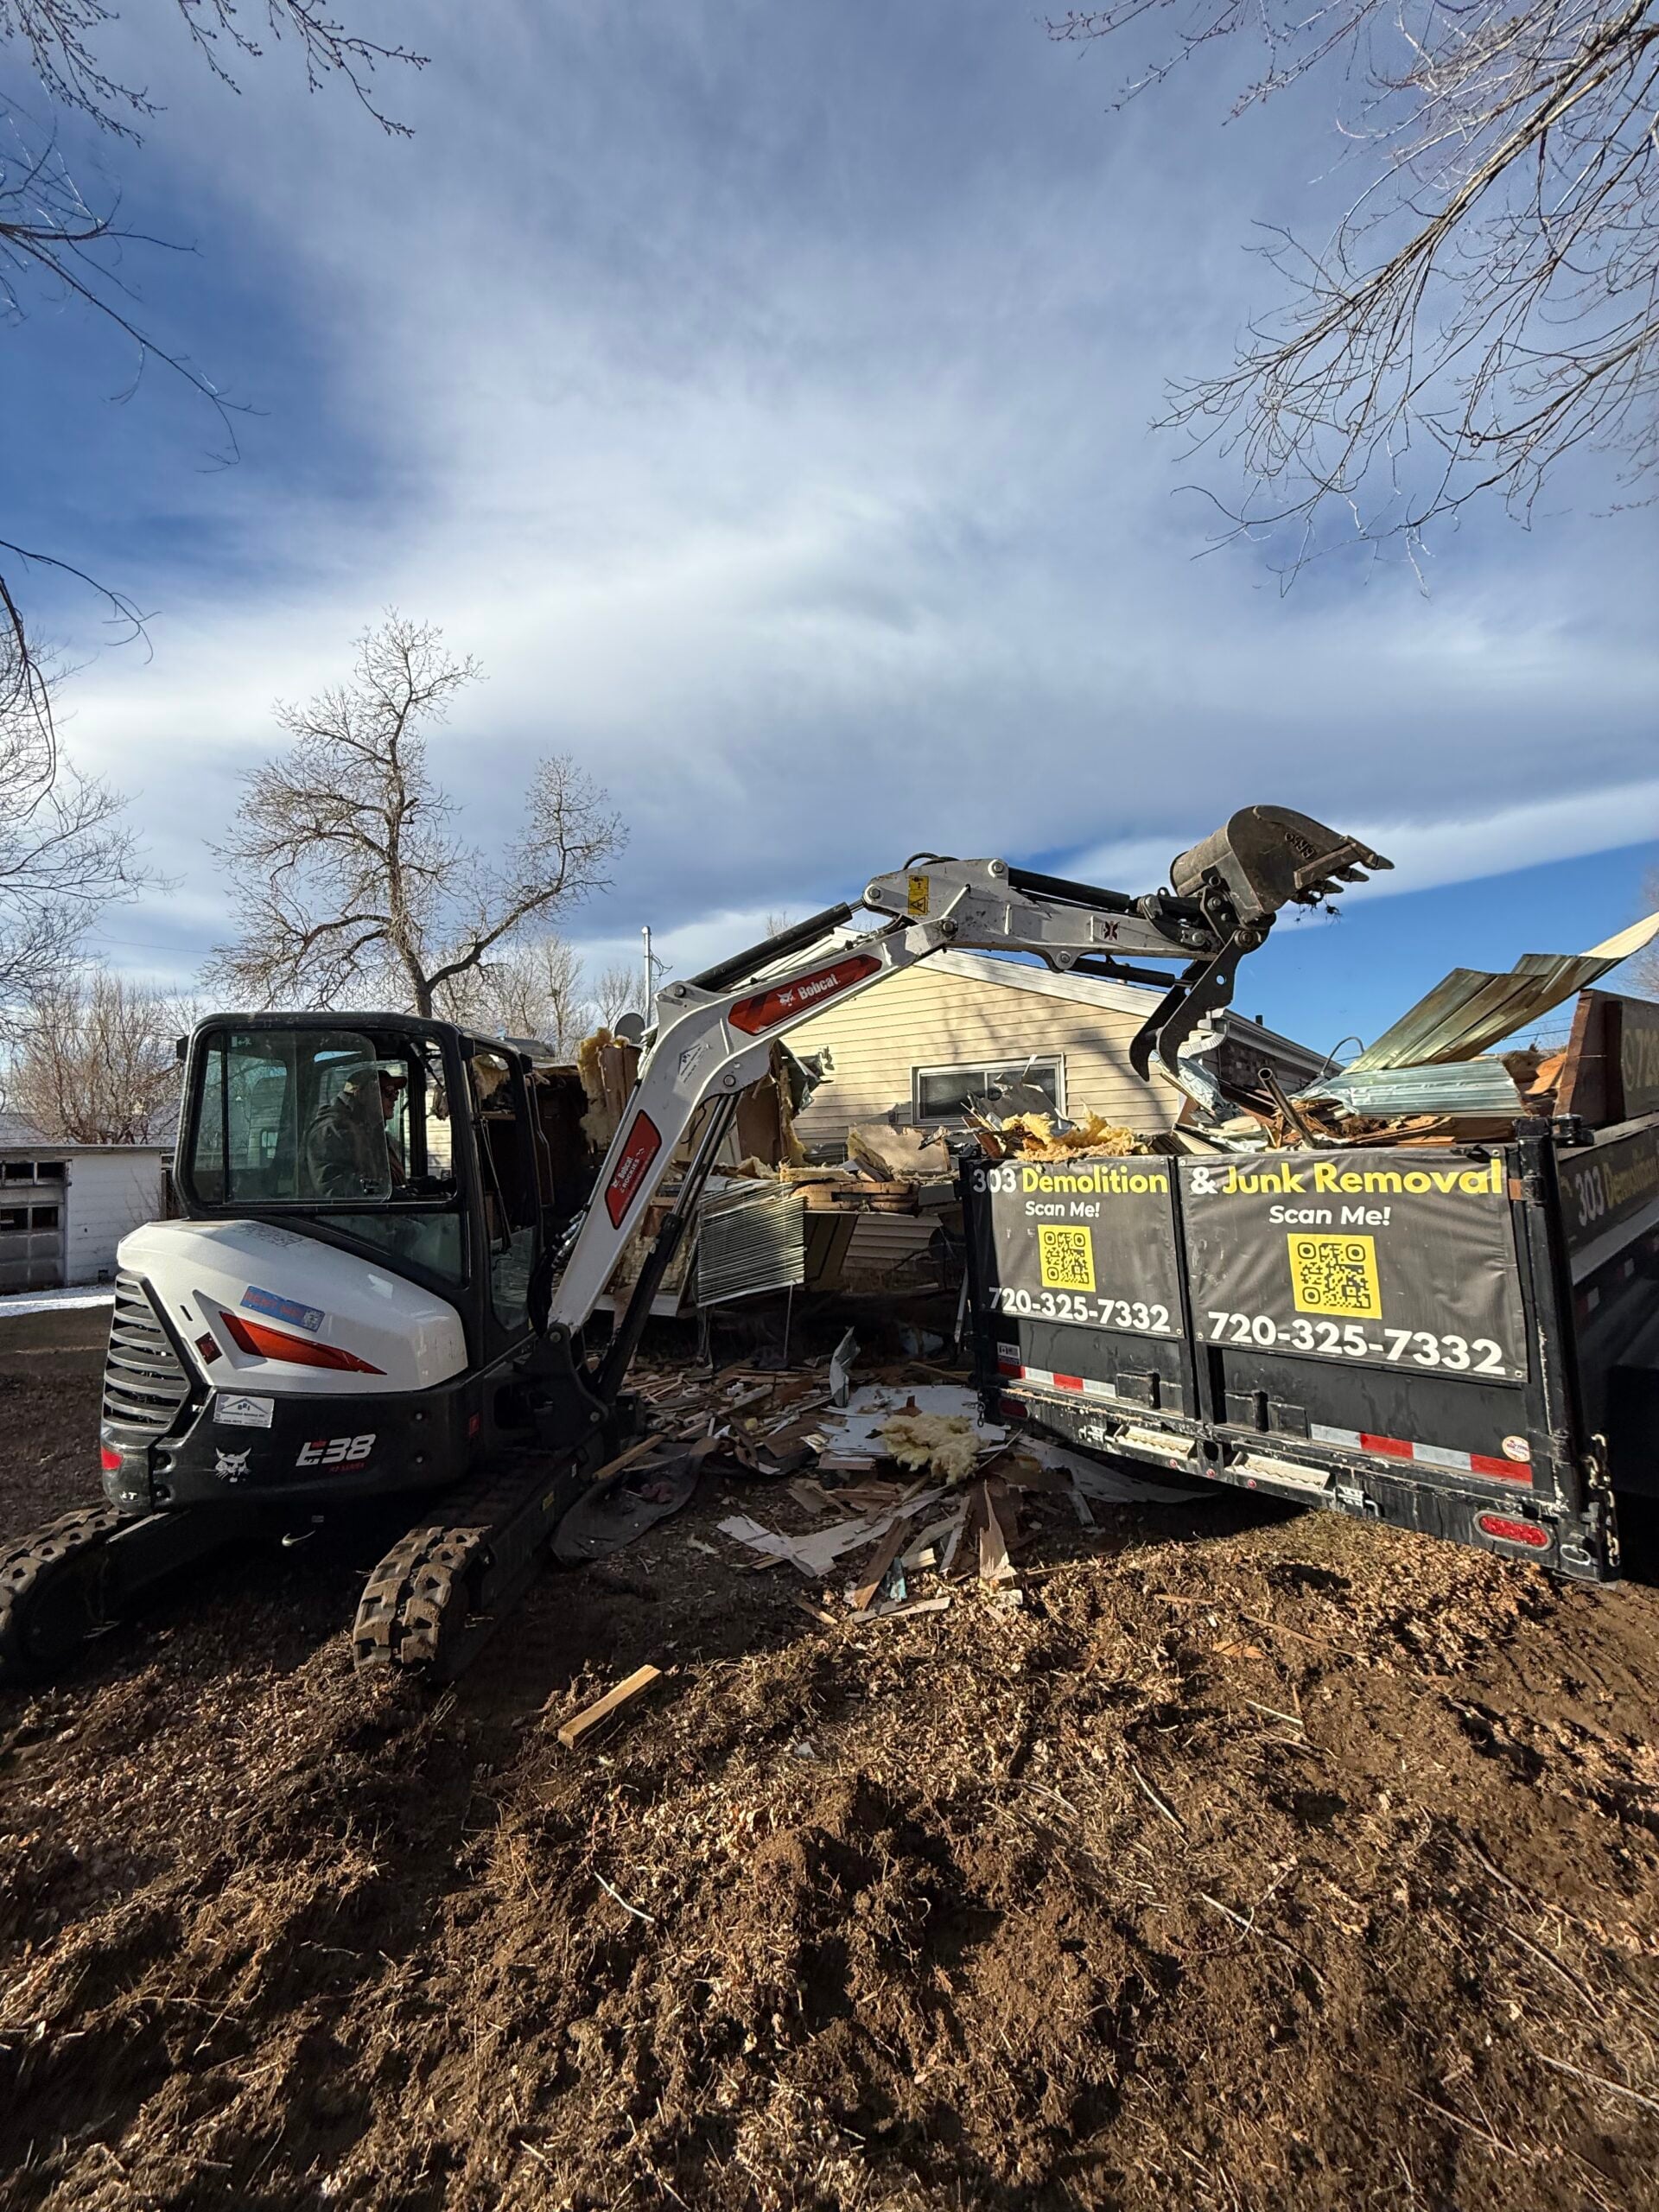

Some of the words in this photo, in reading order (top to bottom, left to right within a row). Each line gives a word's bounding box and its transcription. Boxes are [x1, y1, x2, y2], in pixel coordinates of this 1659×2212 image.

[797, 973, 839, 1001] Bobcat
[973, 1167, 1017, 1193] 303
[1021, 1164, 1168, 1193] Demolition
[1190, 1166, 1218, 1194] &
[1222, 1162, 1306, 1194] Junk
[1313, 1159, 1503, 1195] Removal
[1025, 1201, 1065, 1217] Scan
[1070, 1202, 1101, 1217] Me!
[1575, 1165, 1605, 1226] 303
[1268, 1205, 1332, 1224] Scan
[1340, 1206, 1391, 1226] Me!
[988, 1287, 1172, 1332] 720-325-7332
[1208, 1311, 1506, 1376] 720-325-7332
